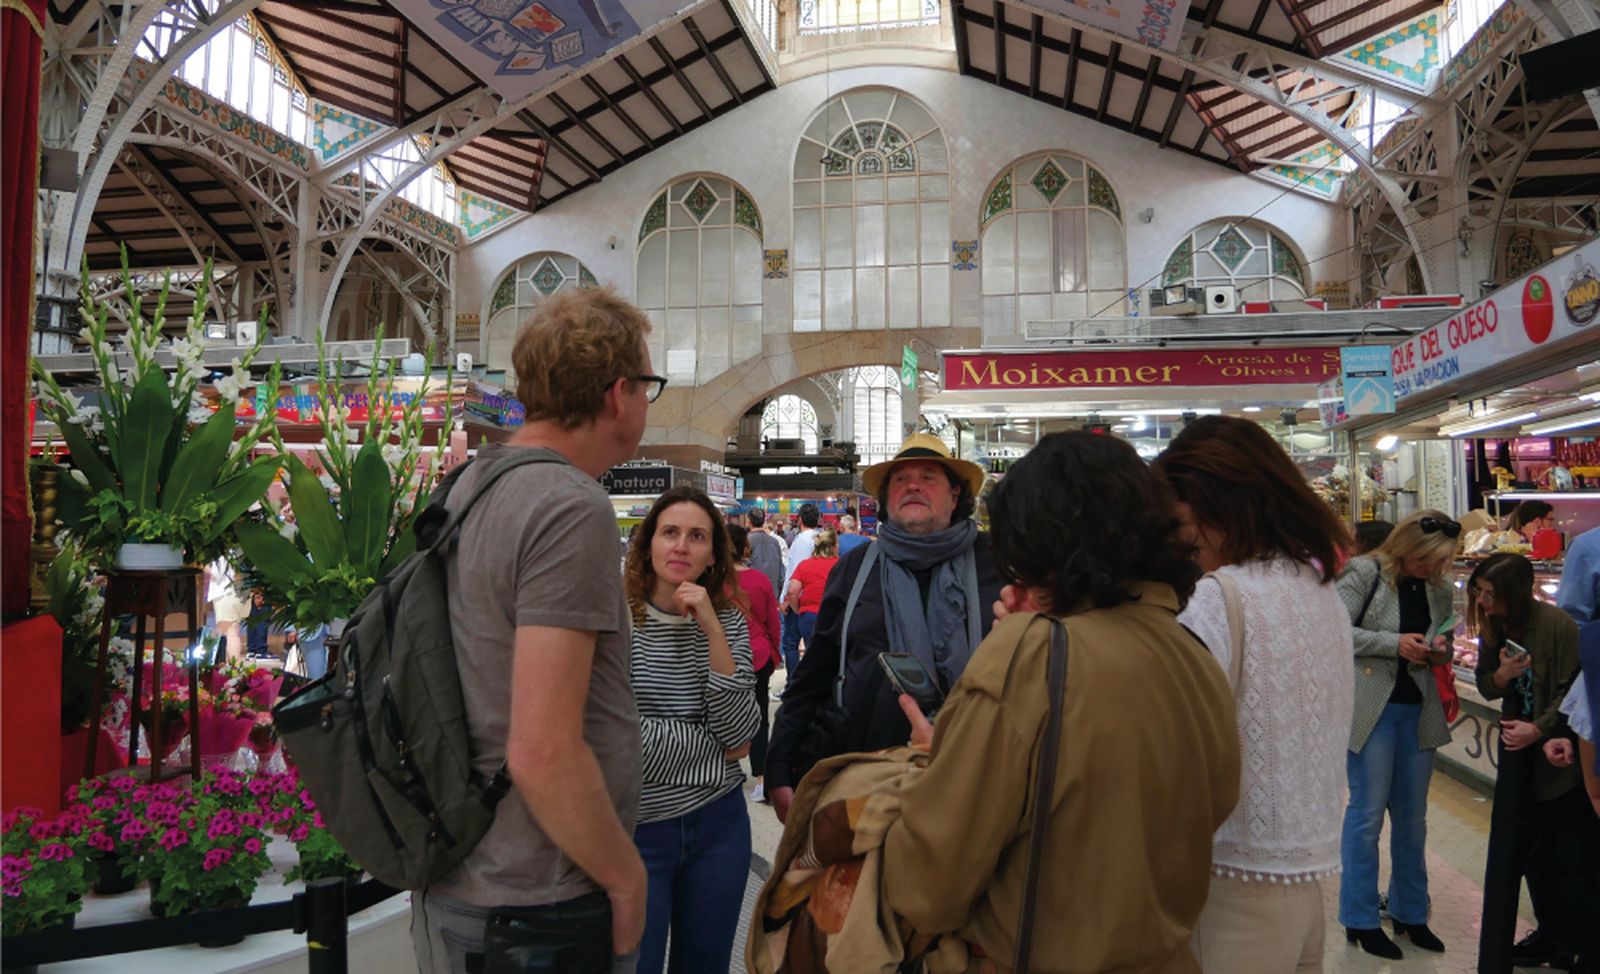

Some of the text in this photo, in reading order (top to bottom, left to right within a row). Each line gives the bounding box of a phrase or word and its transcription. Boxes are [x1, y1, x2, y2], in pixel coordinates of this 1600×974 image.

[1420, 328, 1444, 362] DEL
[1447, 299, 1498, 350] QUESO
[1197, 353, 1275, 365] Artesà
[1284, 352, 1312, 364] de
[958, 359, 1181, 386] Moixamer
[1220, 366, 1295, 377] Olives
[1304, 366, 1311, 376] i
[613, 476, 665, 488] natura
